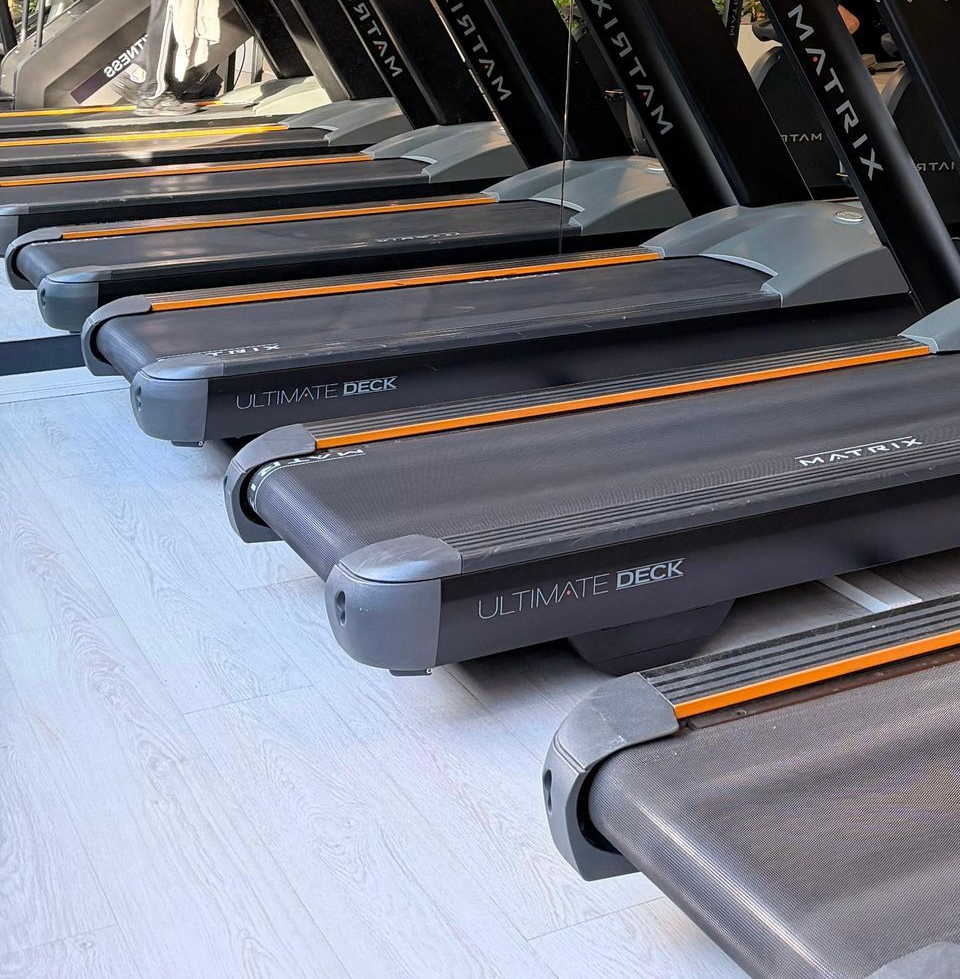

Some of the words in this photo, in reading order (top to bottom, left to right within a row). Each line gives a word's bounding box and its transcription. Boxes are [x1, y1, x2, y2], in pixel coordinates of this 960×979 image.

[787, 4, 884, 181] MATRIX
[236, 382, 338, 410] ULTIMATE
[343, 376, 398, 396] DECK
[799, 438, 923, 467] MATRIX
[478, 573, 610, 620] ULTIMATE
[616, 559, 684, 590] DECK
